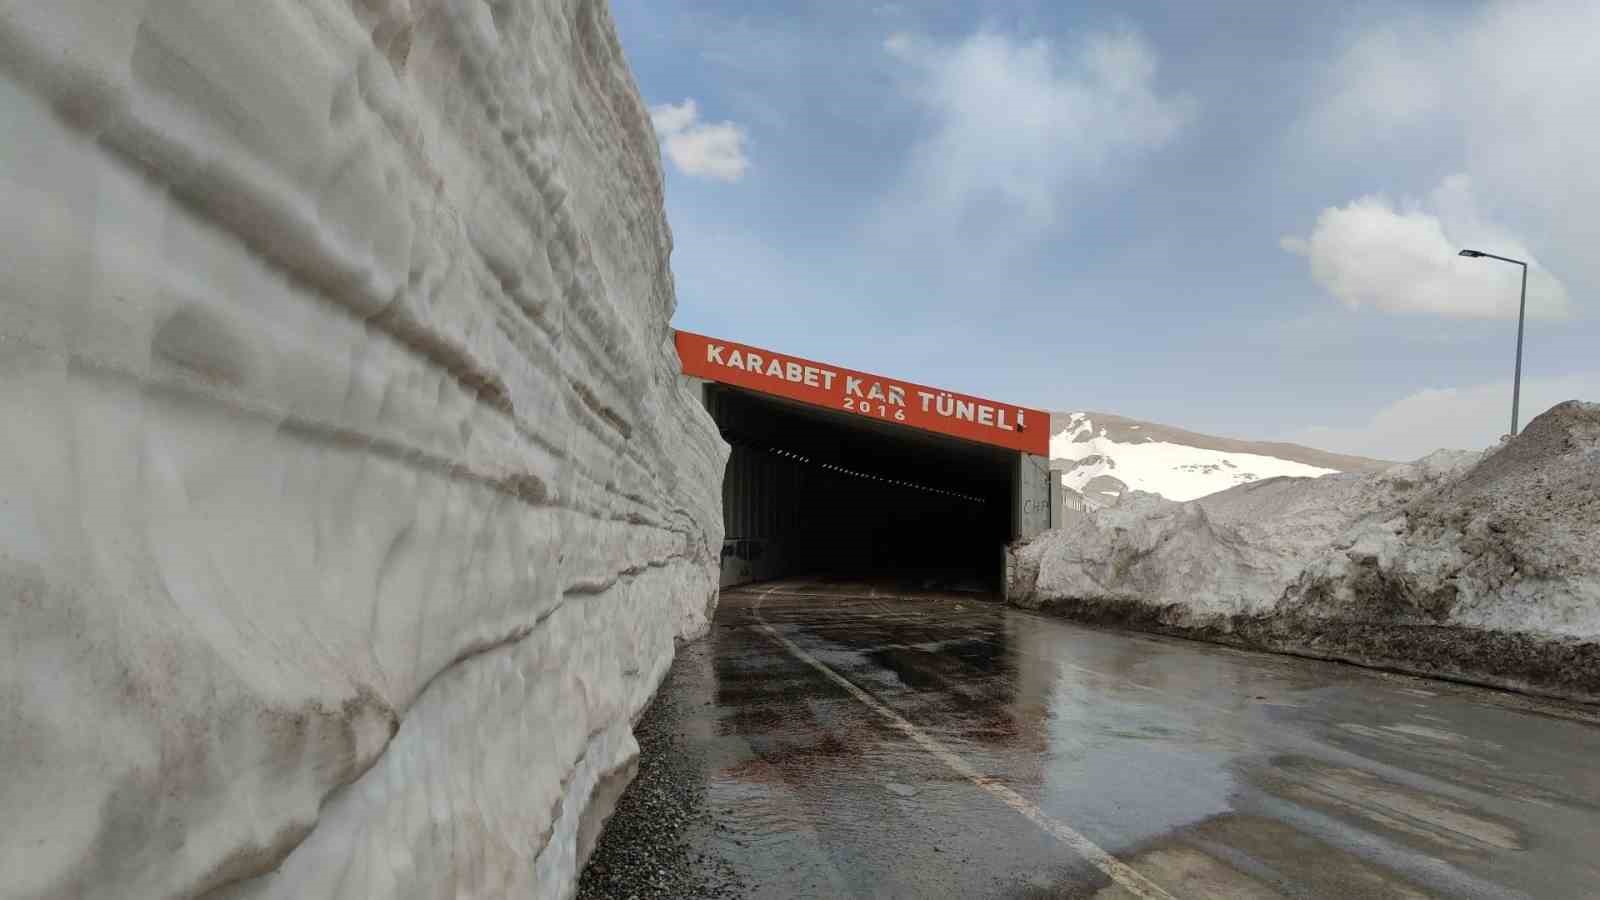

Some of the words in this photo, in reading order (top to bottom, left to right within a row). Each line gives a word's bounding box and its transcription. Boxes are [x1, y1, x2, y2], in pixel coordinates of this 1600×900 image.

[707, 344, 837, 390] KARABET
[845, 375, 906, 407] KAR
[918, 391, 1027, 432] TÜNELİ
[843, 397, 906, 421] 2016
